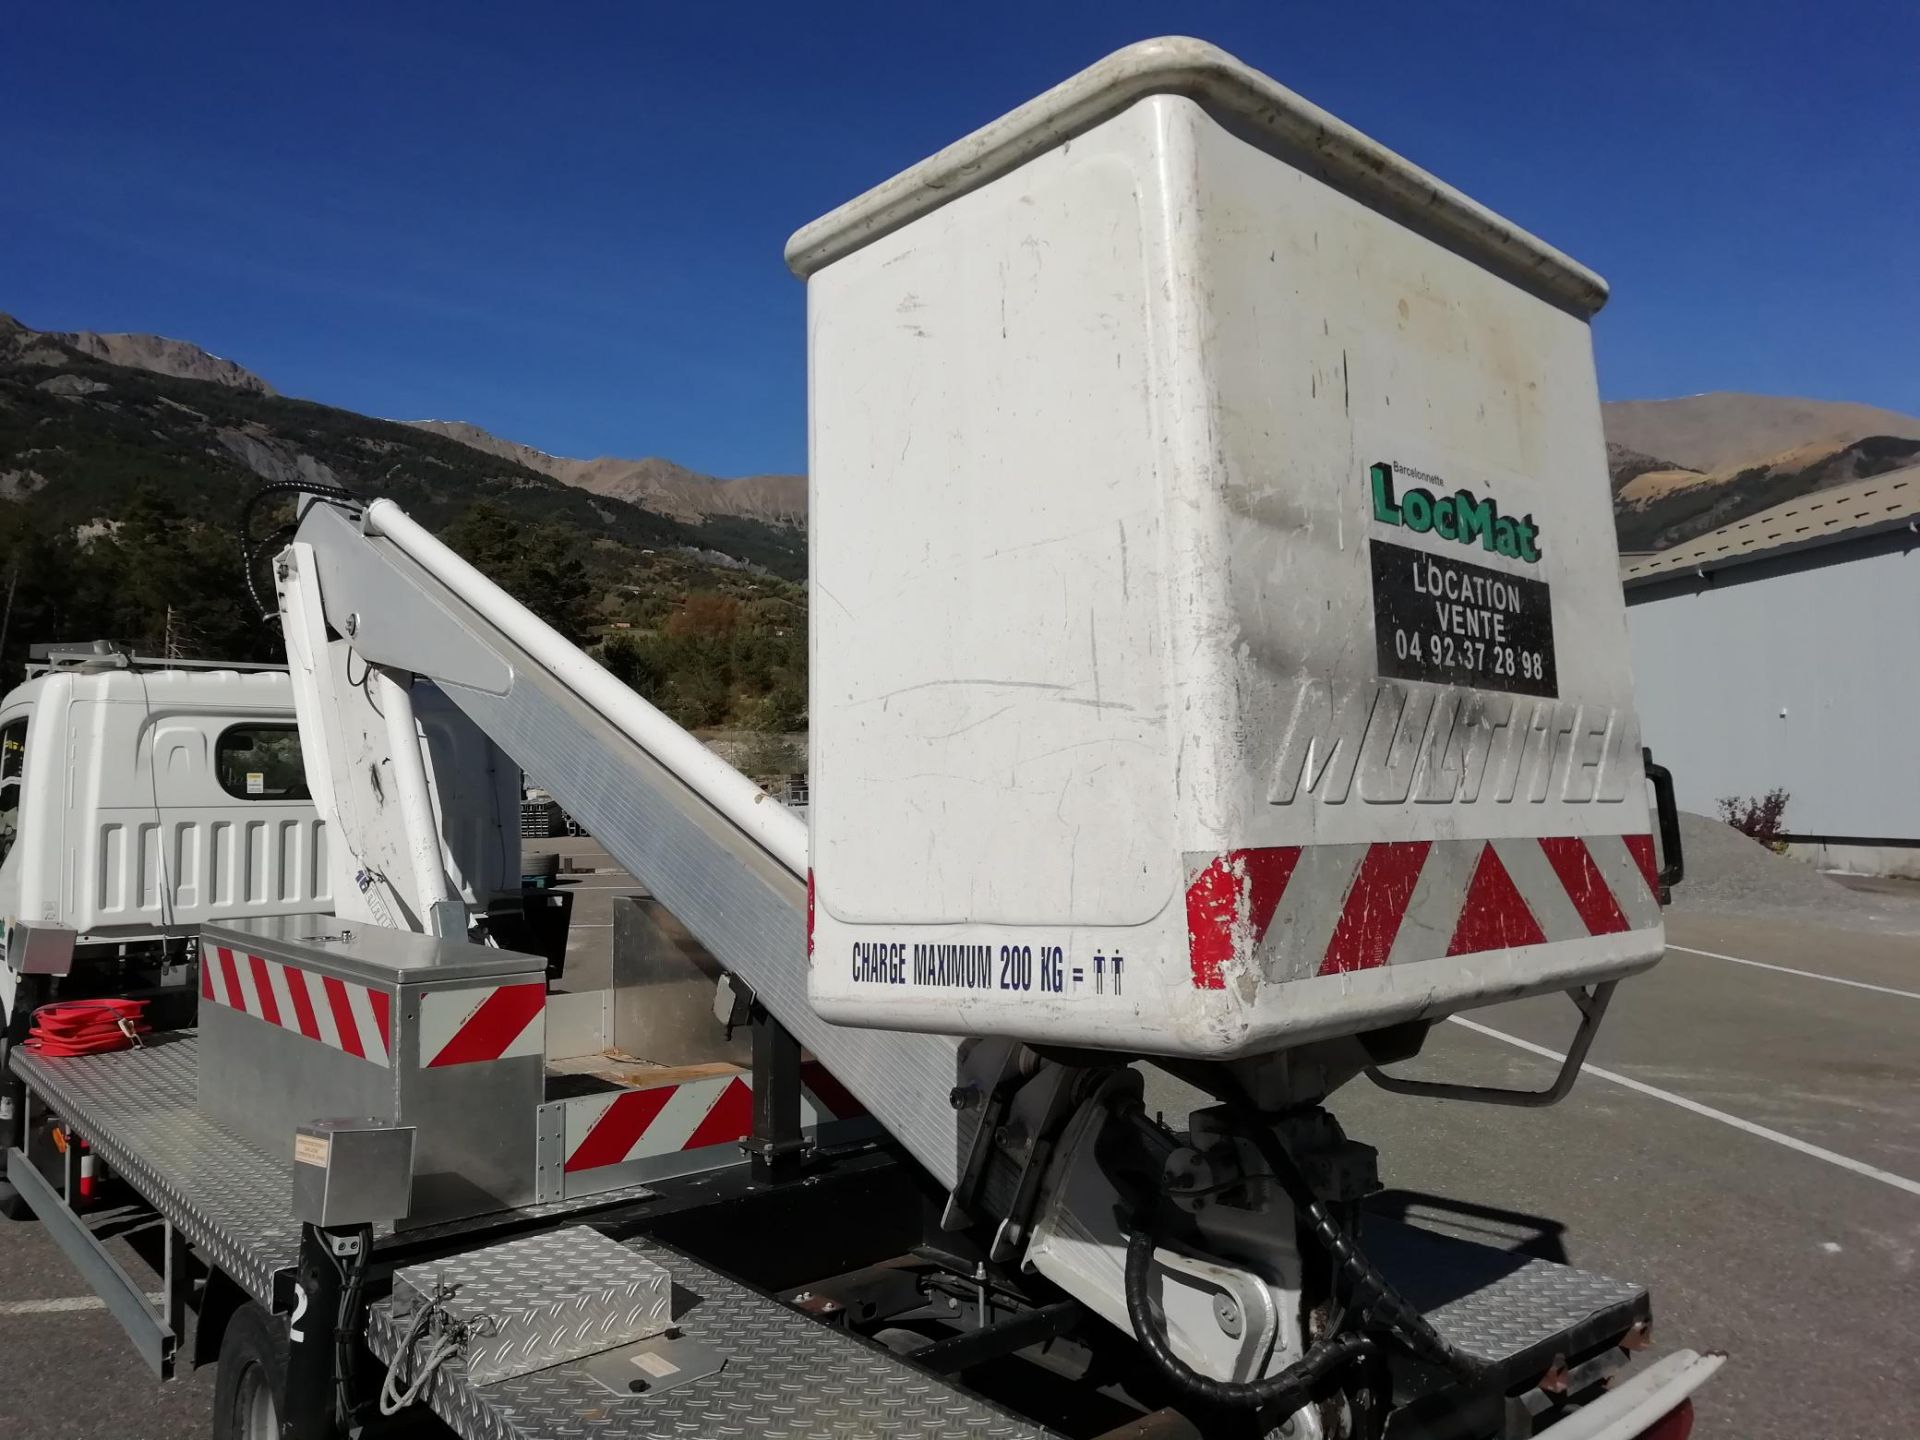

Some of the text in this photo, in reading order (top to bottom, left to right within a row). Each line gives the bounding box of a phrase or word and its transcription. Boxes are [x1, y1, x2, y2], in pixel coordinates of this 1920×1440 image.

[1393, 460, 1445, 488] Barcelonnette
[1369, 461, 1542, 564] LocMat
[1412, 557, 1521, 614] LOCATION
[1435, 601, 1506, 643] VENTE
[1395, 628, 1543, 681] 04 92 37 28 98
[852, 941, 906, 984] CHARGE
[913, 943, 992, 989] MAXIMUM
[1000, 945, 1032, 992] 200
[1040, 946, 1063, 993] KG
[290, 1282, 309, 1343] 2
